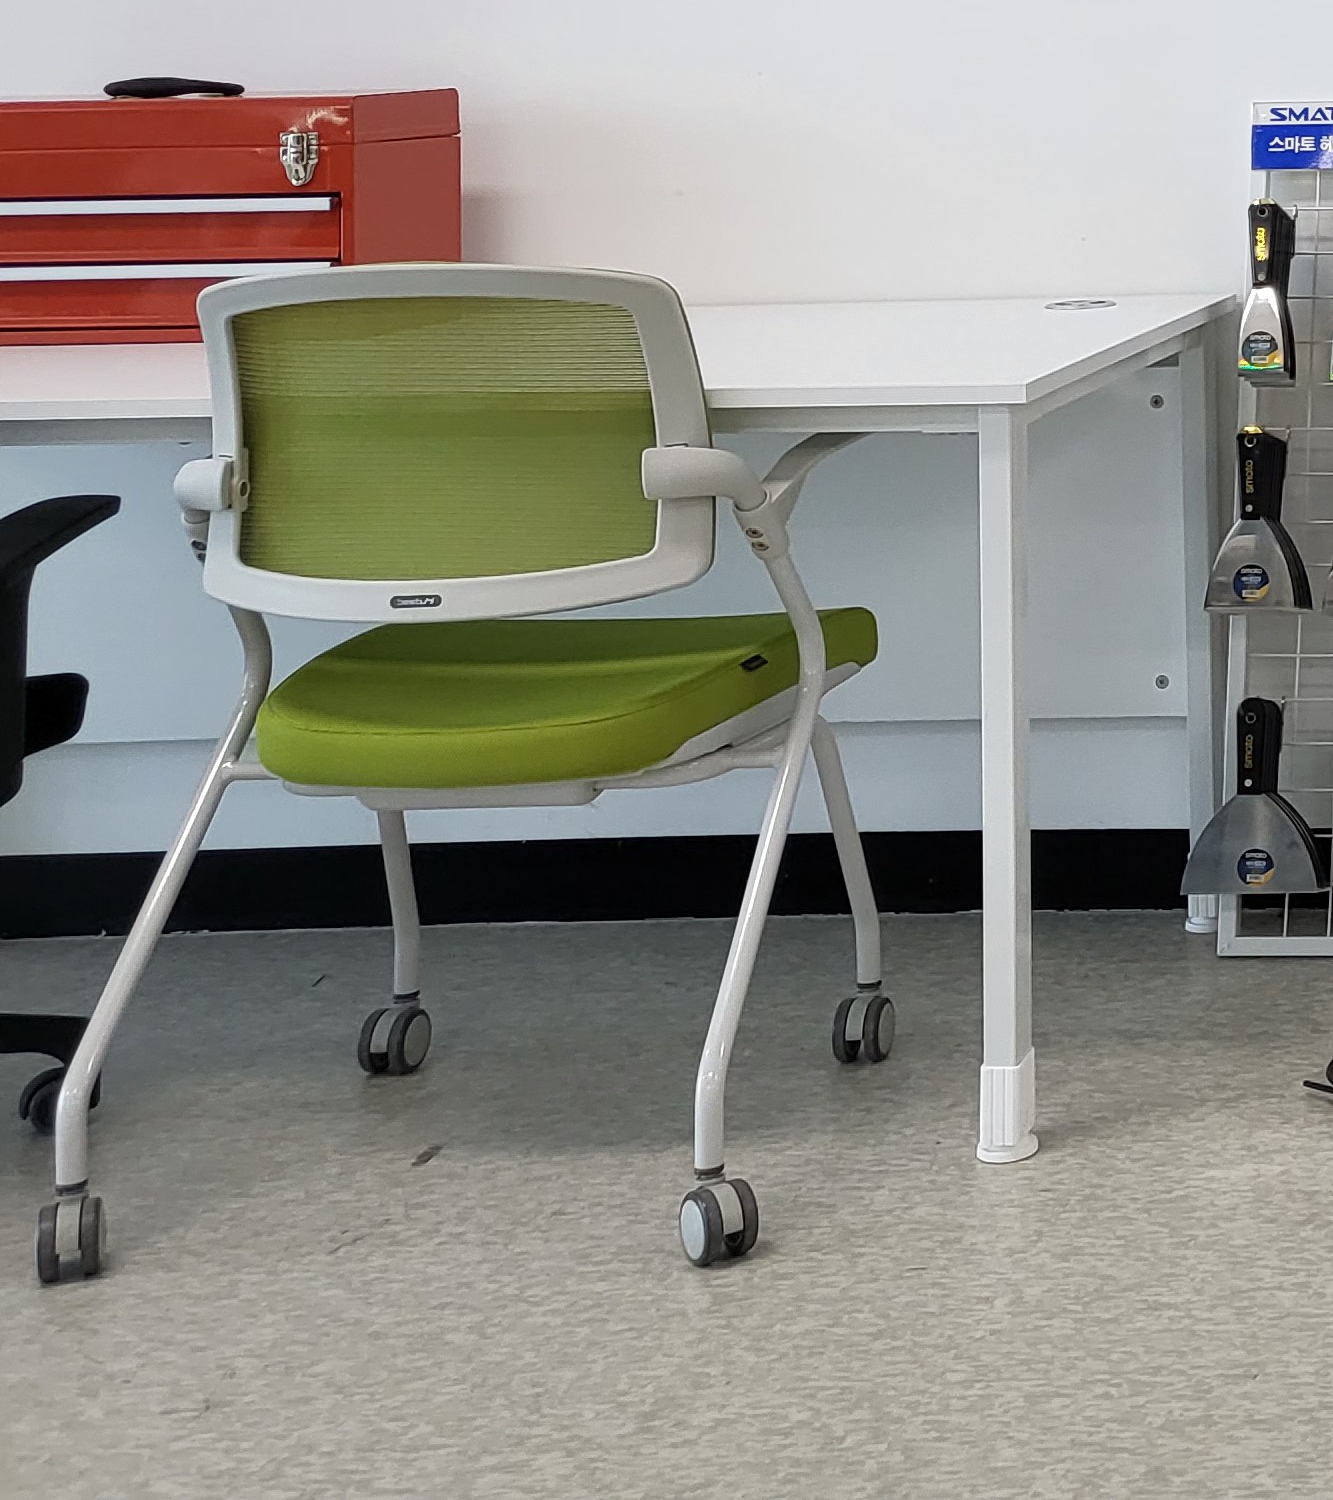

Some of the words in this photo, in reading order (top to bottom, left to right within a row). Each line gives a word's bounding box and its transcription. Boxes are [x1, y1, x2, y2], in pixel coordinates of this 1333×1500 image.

[1268, 135, 1316, 153] 스마토
[1254, 227, 1266, 261] smato
[1245, 460, 1254, 494] smato
[1244, 734, 1254, 768] smato
